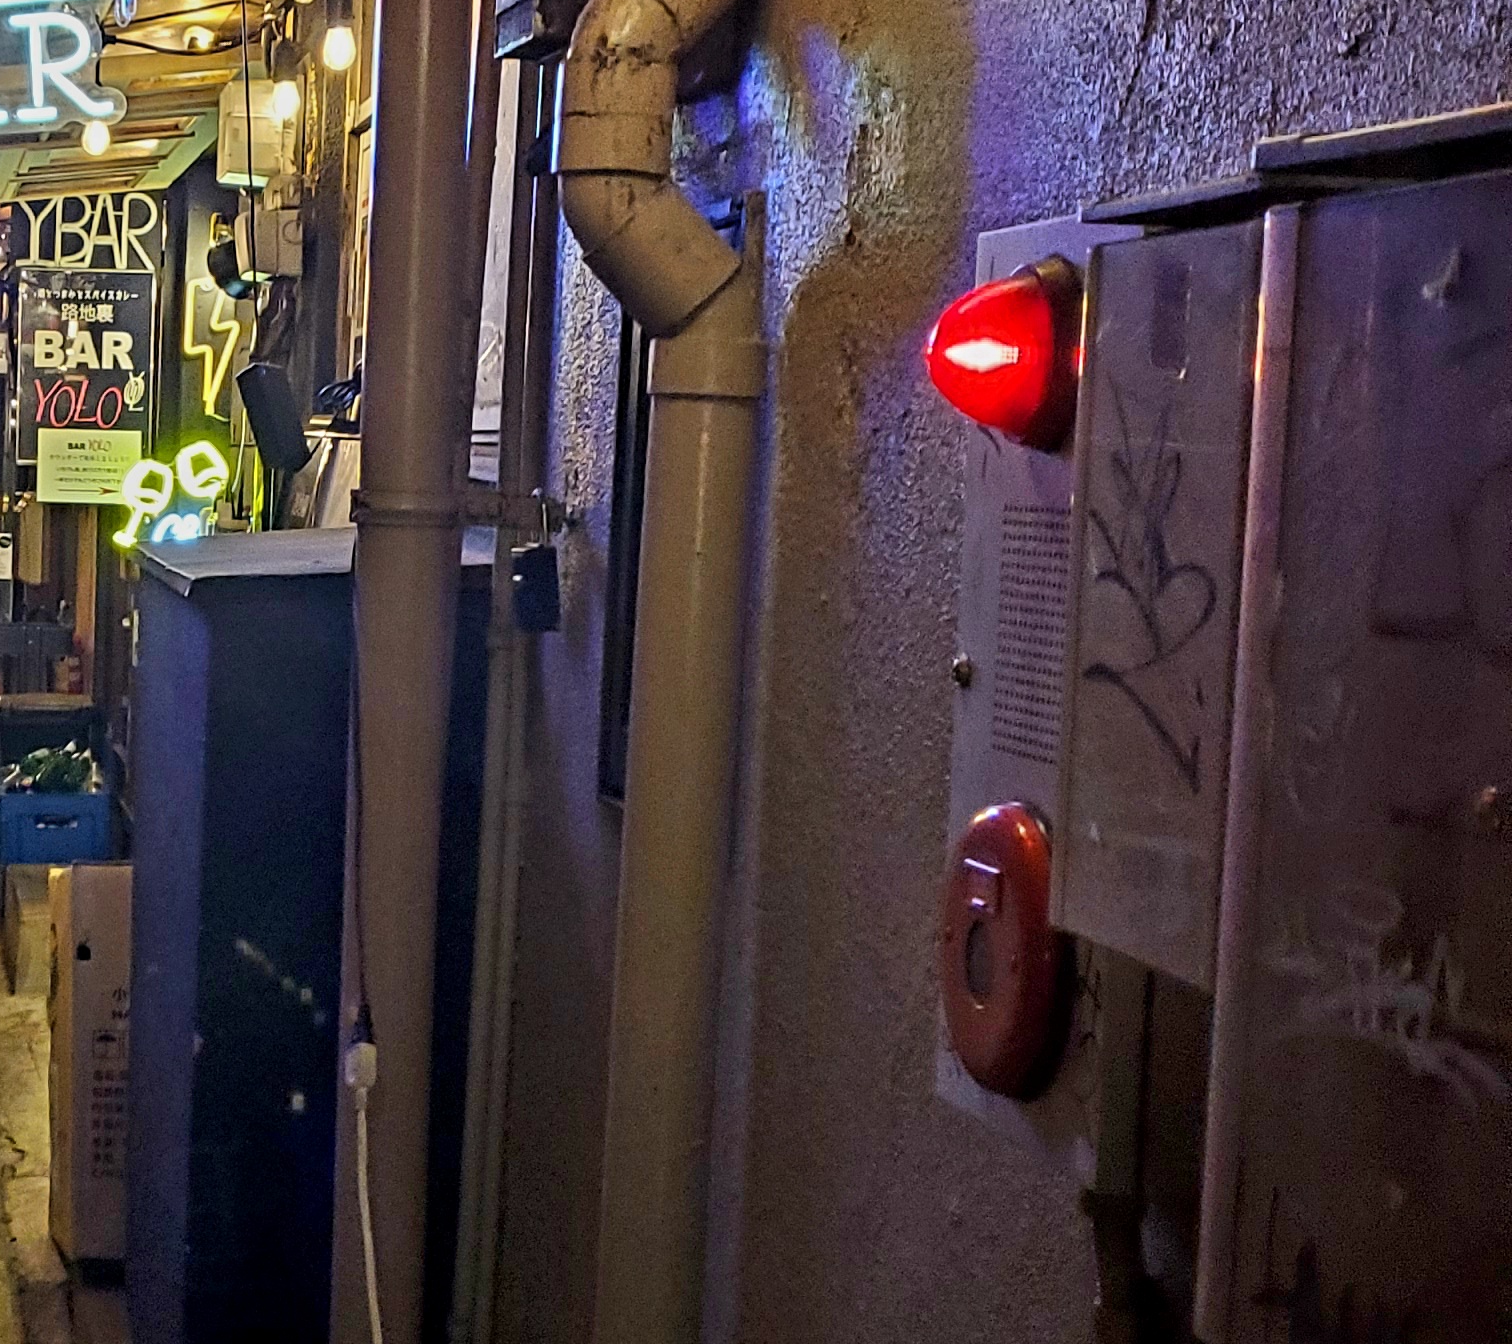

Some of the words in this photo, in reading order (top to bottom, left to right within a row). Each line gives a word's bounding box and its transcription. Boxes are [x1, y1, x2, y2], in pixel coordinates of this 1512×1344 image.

[61, 303, 114, 324] 路地裏
[33, 329, 135, 371] BAR
[33, 378, 123, 429] YOLO
[67, 442, 86, 451] BAR
[87, 439, 113, 452] YOLO
